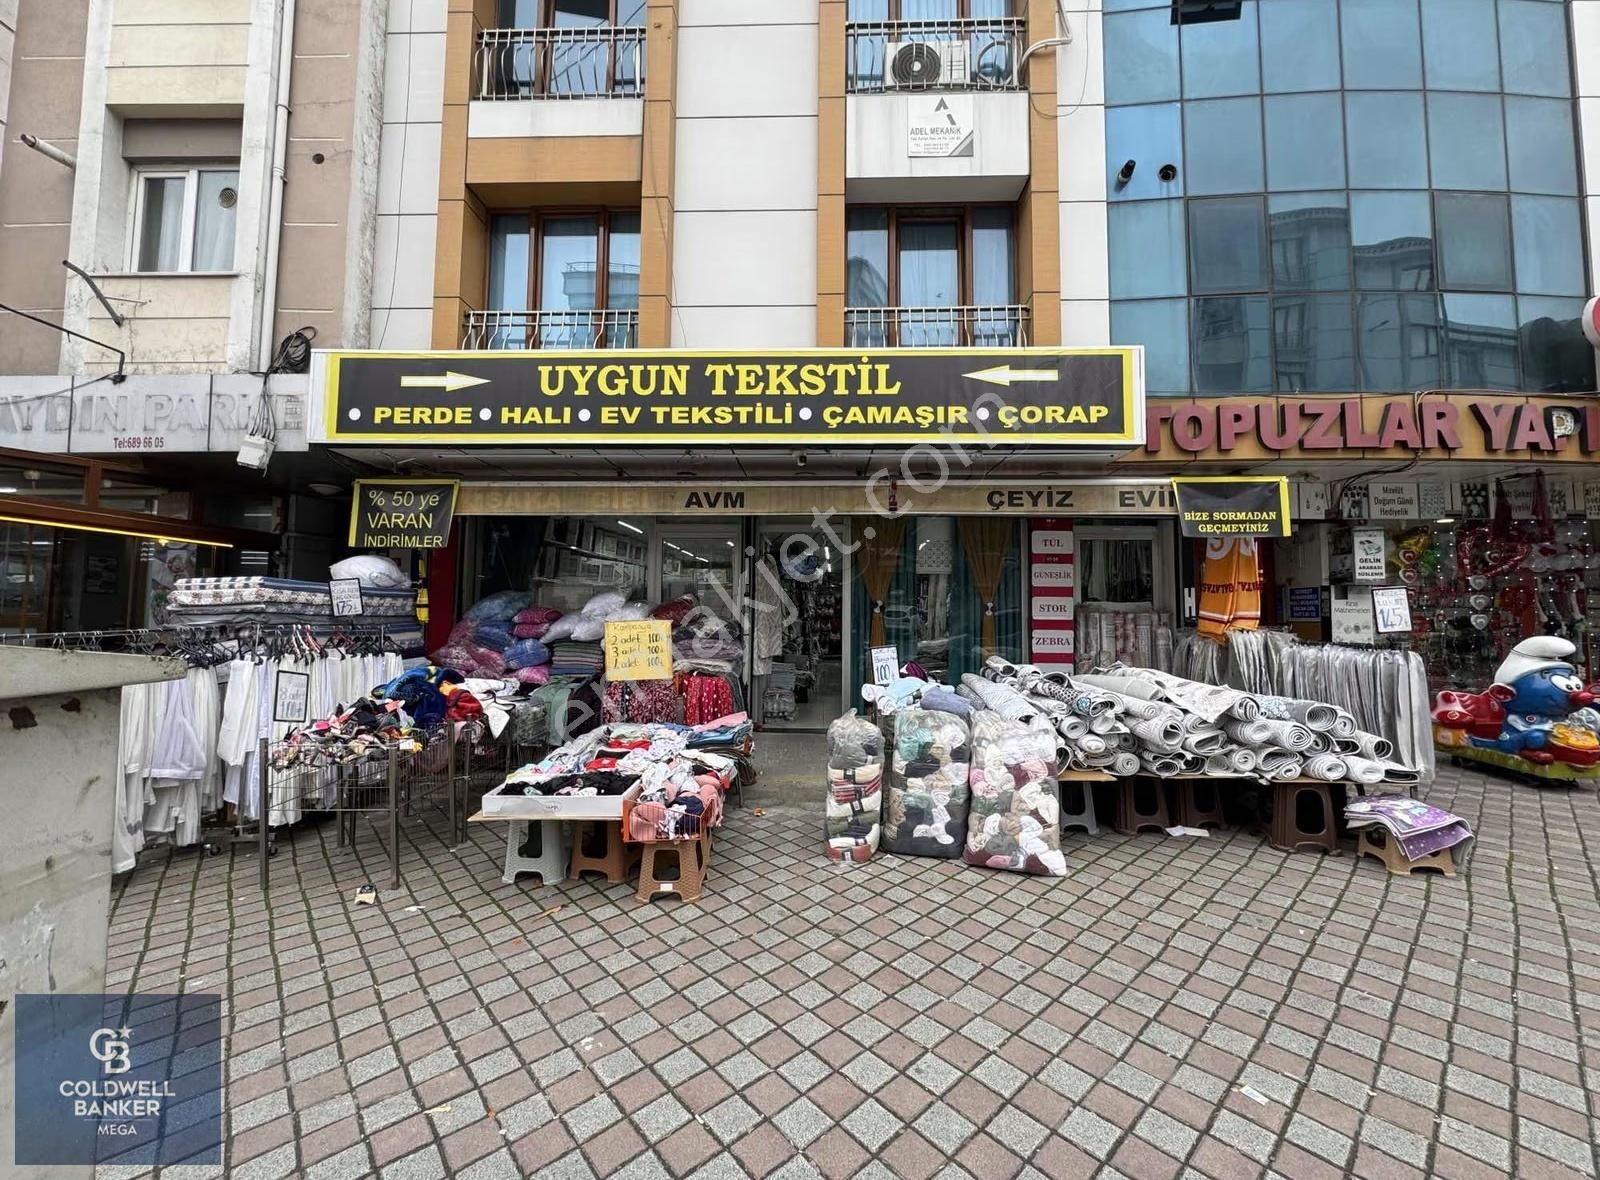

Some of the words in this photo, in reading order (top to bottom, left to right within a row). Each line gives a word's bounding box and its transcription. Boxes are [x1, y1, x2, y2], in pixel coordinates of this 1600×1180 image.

[910, 127, 928, 136] ADEL
[538, 365, 690, 397] UYGUN
[704, 356, 901, 397] TEKSTİL
[373, 407, 473, 425] PERDE
[500, 407, 572, 425] HALI
[601, 407, 642, 425] EV
[650, 402, 793, 425] TEKSTİLİ
[821, 405, 969, 430] ÇAMAŞIR
[997, 405, 1109, 429] ÇORAP
[1146, 401, 1463, 453] TOPUZLAR
[1468, 402, 1600, 455] YAPI
[113, 437, 142, 449] Tel:689
[143, 438, 153, 449] 66
[154, 438, 165, 449] 05
[368, 490, 385, 507] %
[393, 491, 414, 507] 50
[418, 494, 440, 511] ye
[684, 492, 746, 509] AVM
[986, 485, 1074, 511] ÇEYİZ
[366, 512, 433, 529] VARAN
[1184, 511, 1210, 521] BİZE
[1213, 511, 1277, 521] SORMADAN
[1198, 522, 1270, 534] GEÇMEYİNİZ
[363, 532, 443, 549] İNDİRİMLER
[1041, 537, 1064, 548] TÜL
[1038, 603, 1068, 614] STOR
[1035, 636, 1071, 647] ZEBRA
